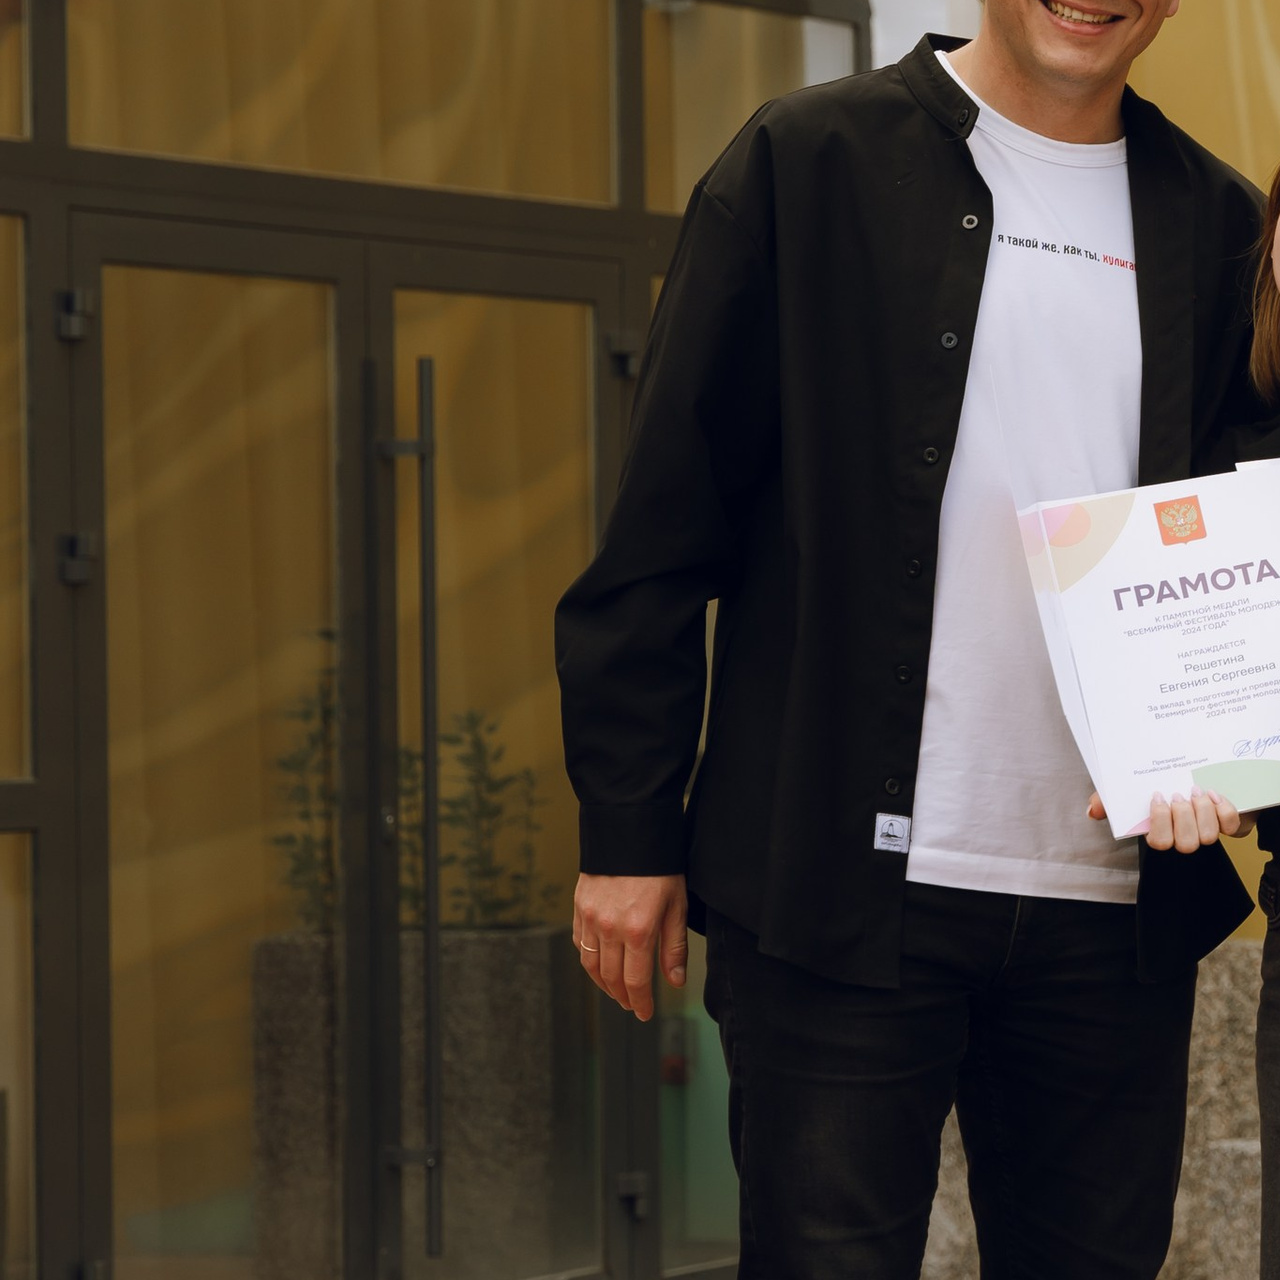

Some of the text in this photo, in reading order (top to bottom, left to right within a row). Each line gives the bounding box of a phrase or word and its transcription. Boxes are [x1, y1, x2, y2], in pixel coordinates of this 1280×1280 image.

[1007, 235, 1038, 249] такой
[1063, 245, 1082, 256] как
[1113, 559, 1280, 611] ГРАМОТА
[1162, 604, 1212, 622] ПАМЯТНОЙ
[1213, 597, 1250, 611] МЕДАЛИ
[1123, 619, 1183, 637] "ВСЕМИРНЫЙ
[1183, 610, 1237, 627] ФЕСТИВАЛЬ
[1181, 619, 1230, 636] 2024 ГОДА"
[1177, 639, 1246, 659] НАГРАЖДАЕТСЯ
[1184, 653, 1245, 674] Решетина
[1159, 660, 1276, 694] Евгения Сергеевна
[1147, 705, 1158, 713] За
[1160, 699, 1185, 711] вклад
[1193, 687, 1241, 706] подготовку
[1154, 705, 1206, 721] Всемирного
[1206, 694, 1251, 711] фестиваля
[1206, 704, 1247, 719] 2024 года
[1133, 757, 1209, 776] Российской Федерации
[1152, 755, 1186, 766] Президент
